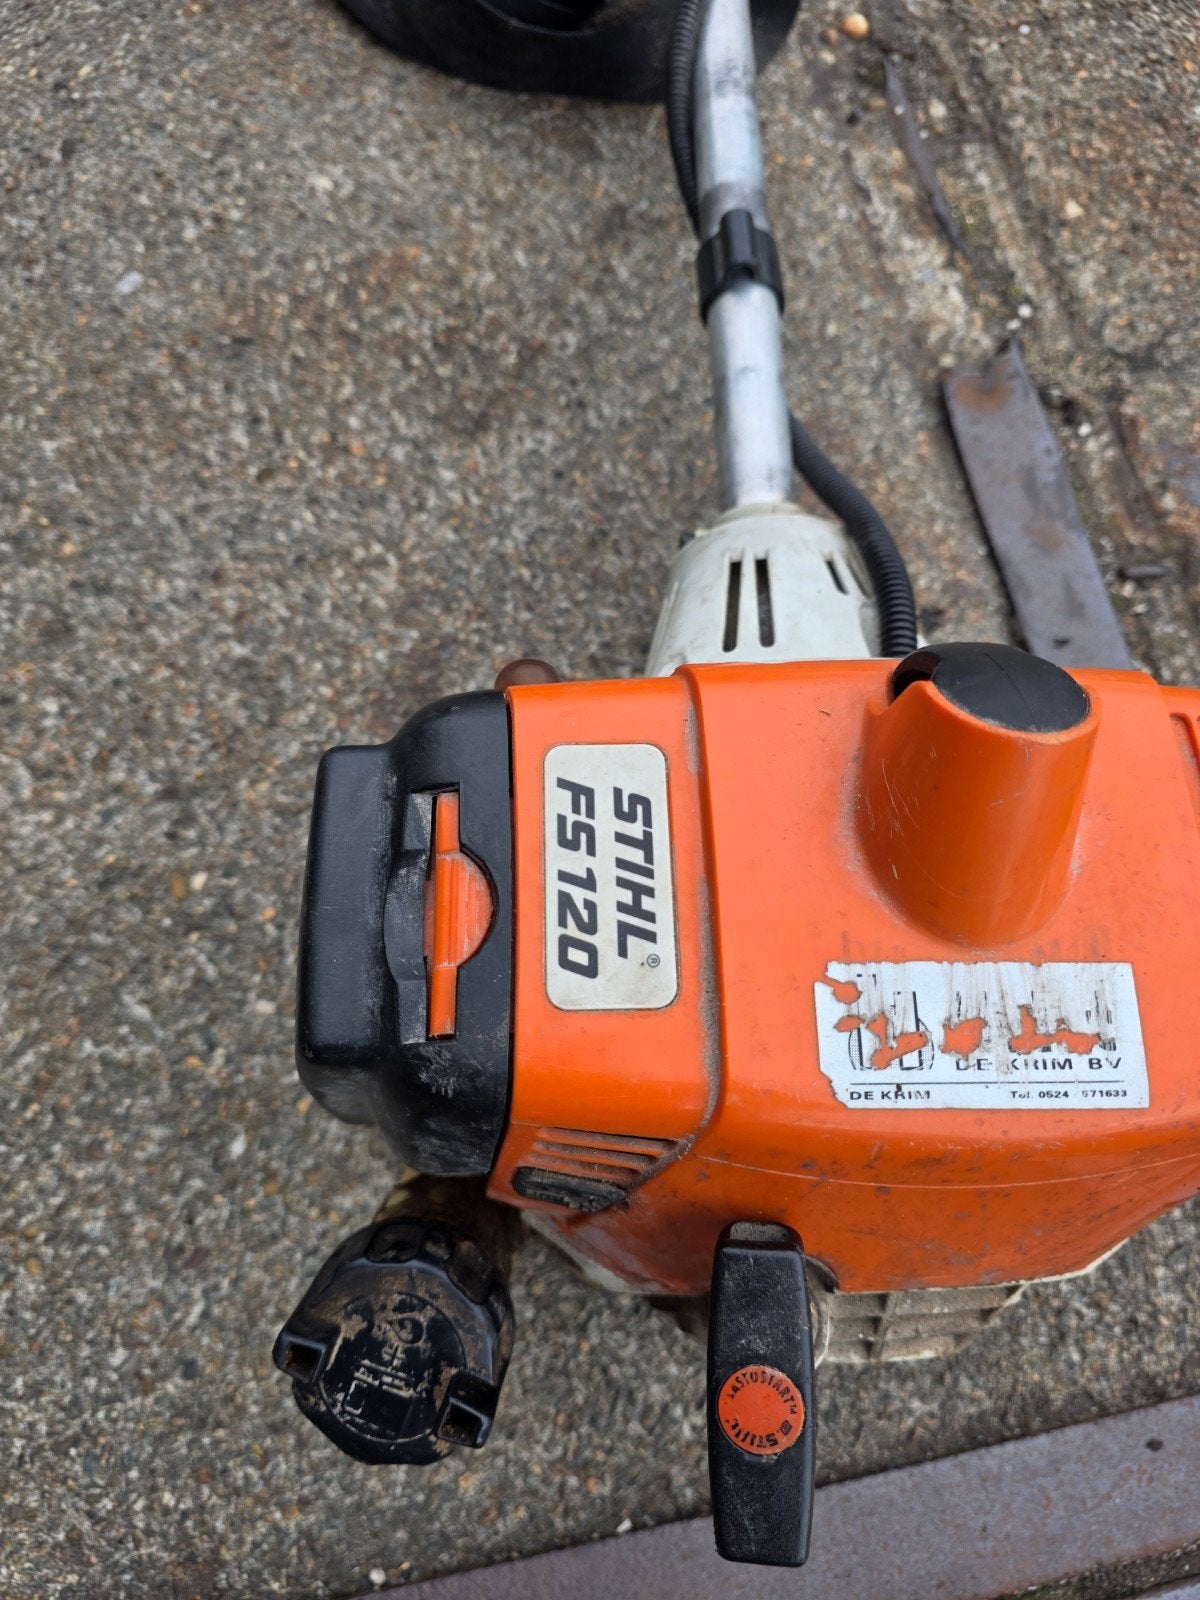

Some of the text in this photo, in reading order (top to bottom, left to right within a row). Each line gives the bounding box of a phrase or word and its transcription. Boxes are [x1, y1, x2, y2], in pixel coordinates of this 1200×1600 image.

[556, 777, 599, 979] FS 120
[613, 786, 657, 960] STIHL
[849, 1090, 874, 1101] DE
[1038, 1090, 1069, 1099] 0524
